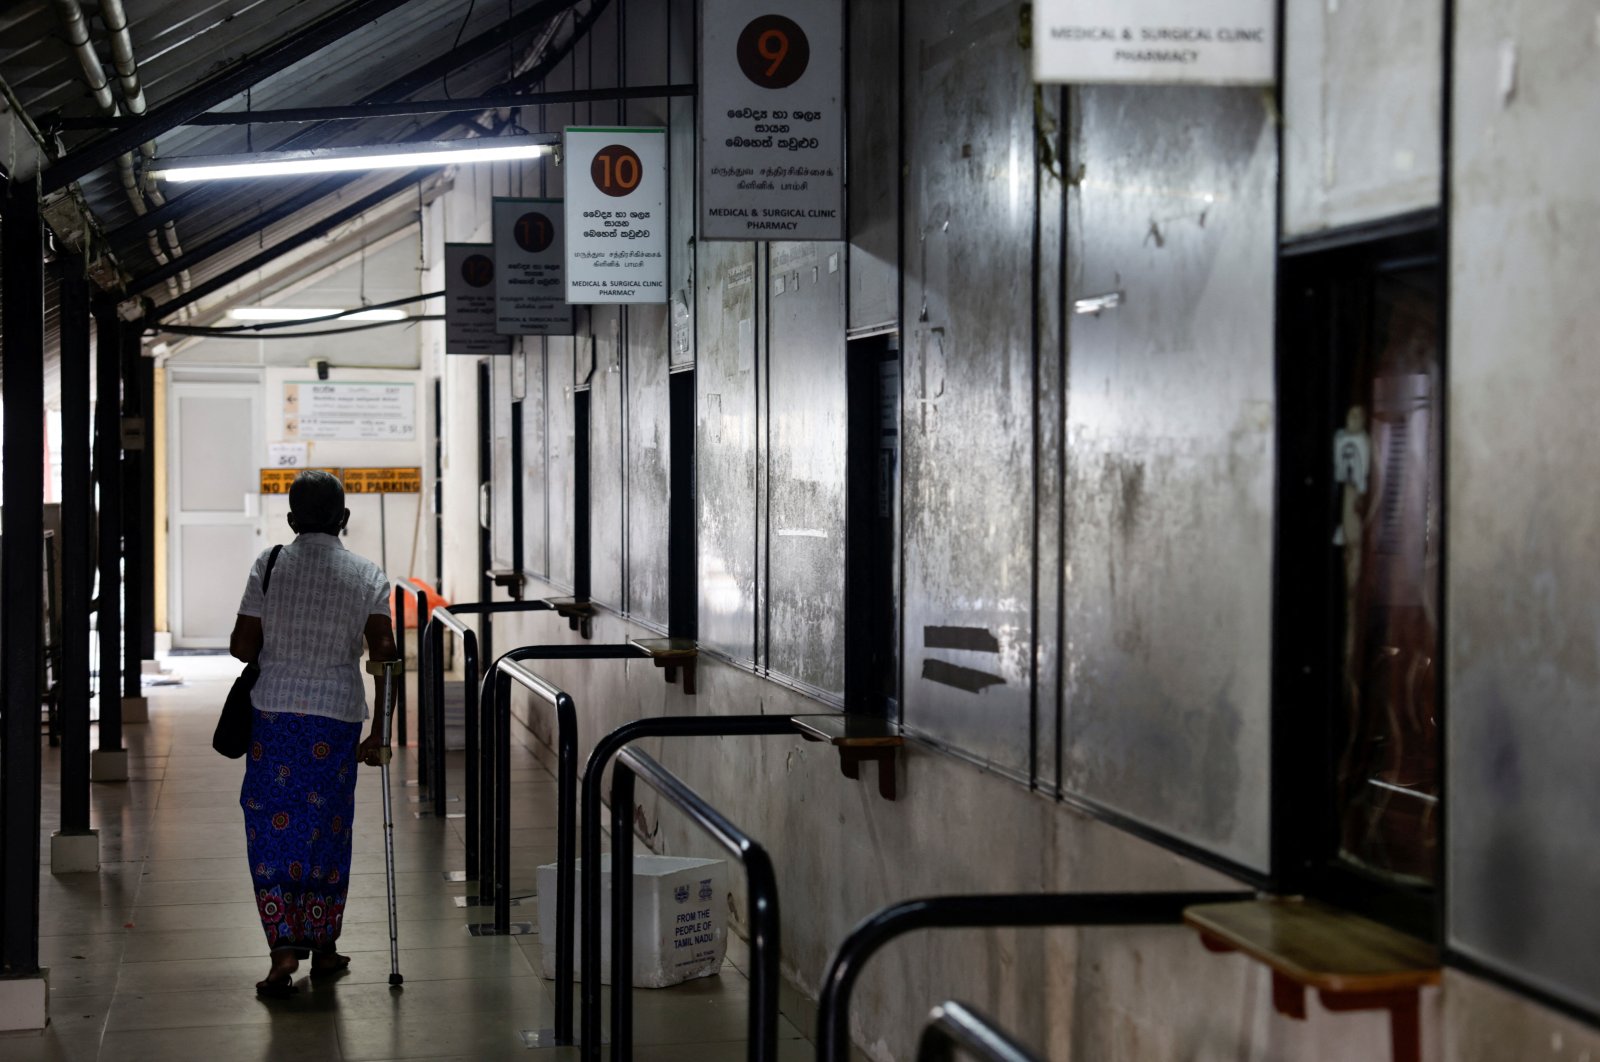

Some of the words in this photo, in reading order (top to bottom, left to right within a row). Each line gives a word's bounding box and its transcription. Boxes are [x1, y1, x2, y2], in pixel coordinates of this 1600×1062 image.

[1051, 28, 1115, 40] MEDICAL
[1122, 28, 1132, 40] &
[1141, 27, 1212, 41] SURGICAL
[1217, 28, 1264, 41] CLINIC
[758, 29, 789, 77] 9
[1115, 50, 1198, 62] PHARMACY
[598, 155, 638, 189] 10
[709, 208, 749, 217] MEDICAL
[751, 209, 758, 217] &
[763, 209, 805, 218] SURGICAL
[808, 209, 836, 218] CLINIC
[747, 221, 798, 230] PHARMACY
[519, 221, 545, 246] 11
[263, 482, 280, 492] NO
[345, 482, 362, 491] NO
[367, 481, 420, 492] PARKING
[677, 911, 696, 924] FROM
[697, 909, 710, 918] THE
[676, 923, 701, 936] PEOPLE
[703, 921, 712, 931] OF
[674, 938, 693, 949] TAMIL
[694, 933, 713, 944] NADU
